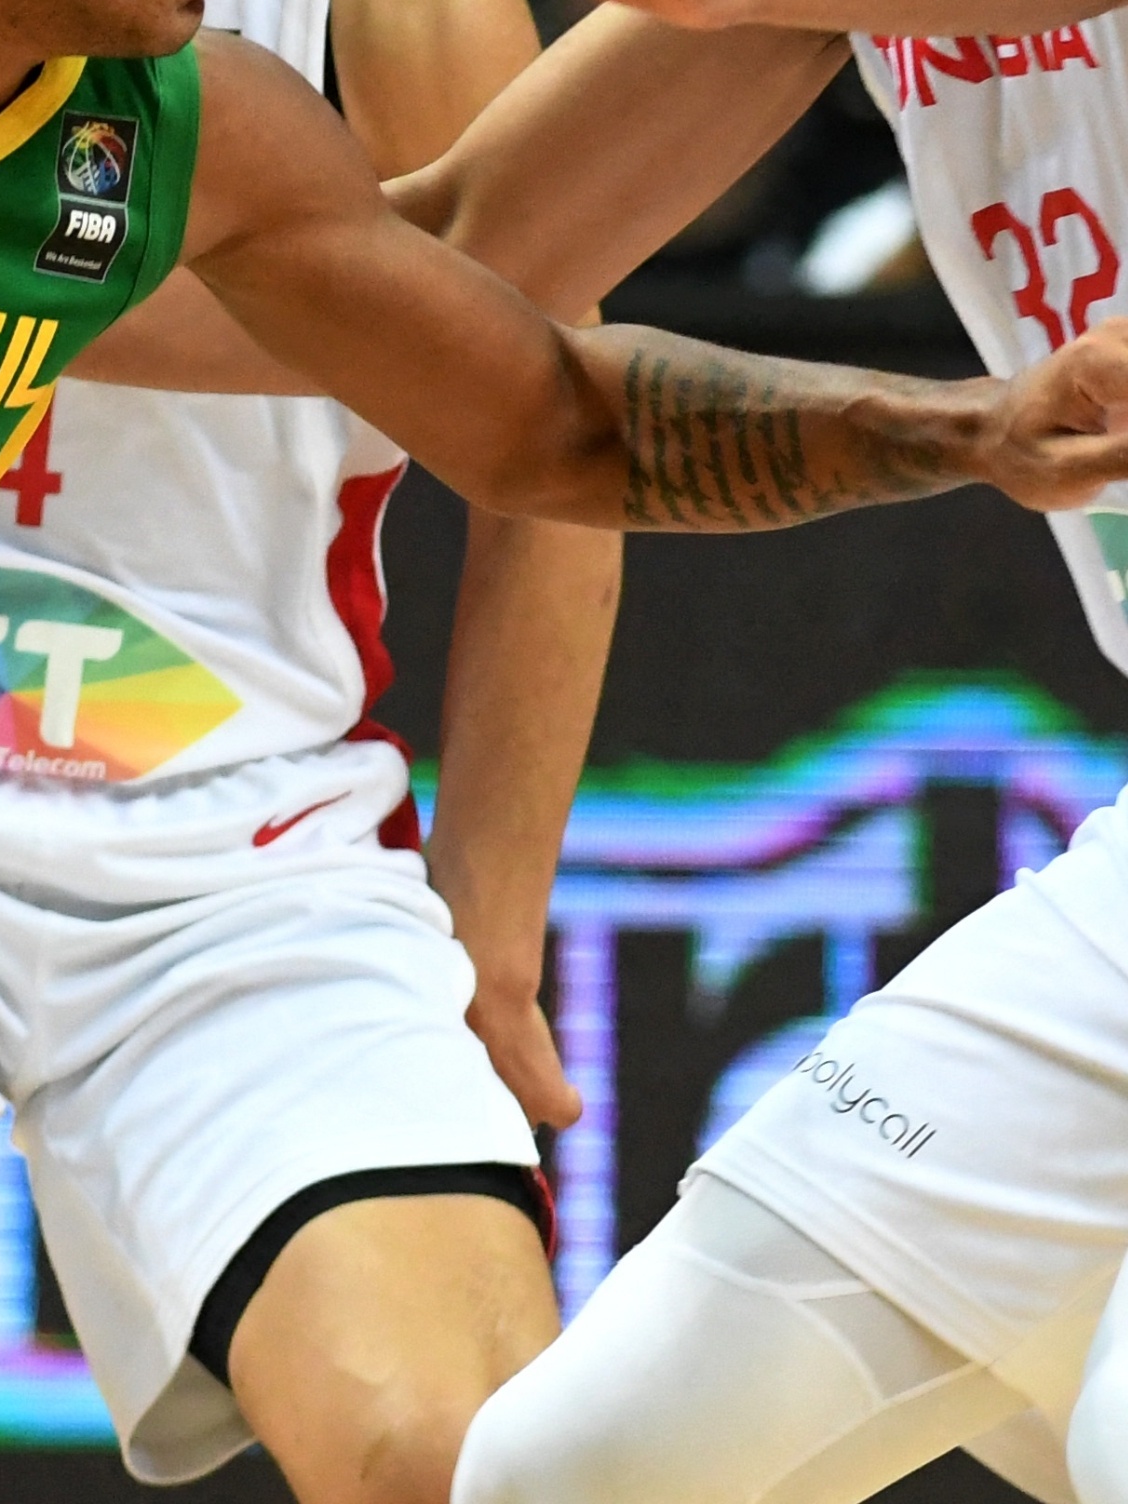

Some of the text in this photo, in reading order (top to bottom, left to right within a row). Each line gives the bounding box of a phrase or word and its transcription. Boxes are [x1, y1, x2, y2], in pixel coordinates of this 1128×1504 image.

[64, 209, 117, 244] FIBA
[970, 186, 1120, 354] 32
[792, 1051, 939, 1159] polycall
